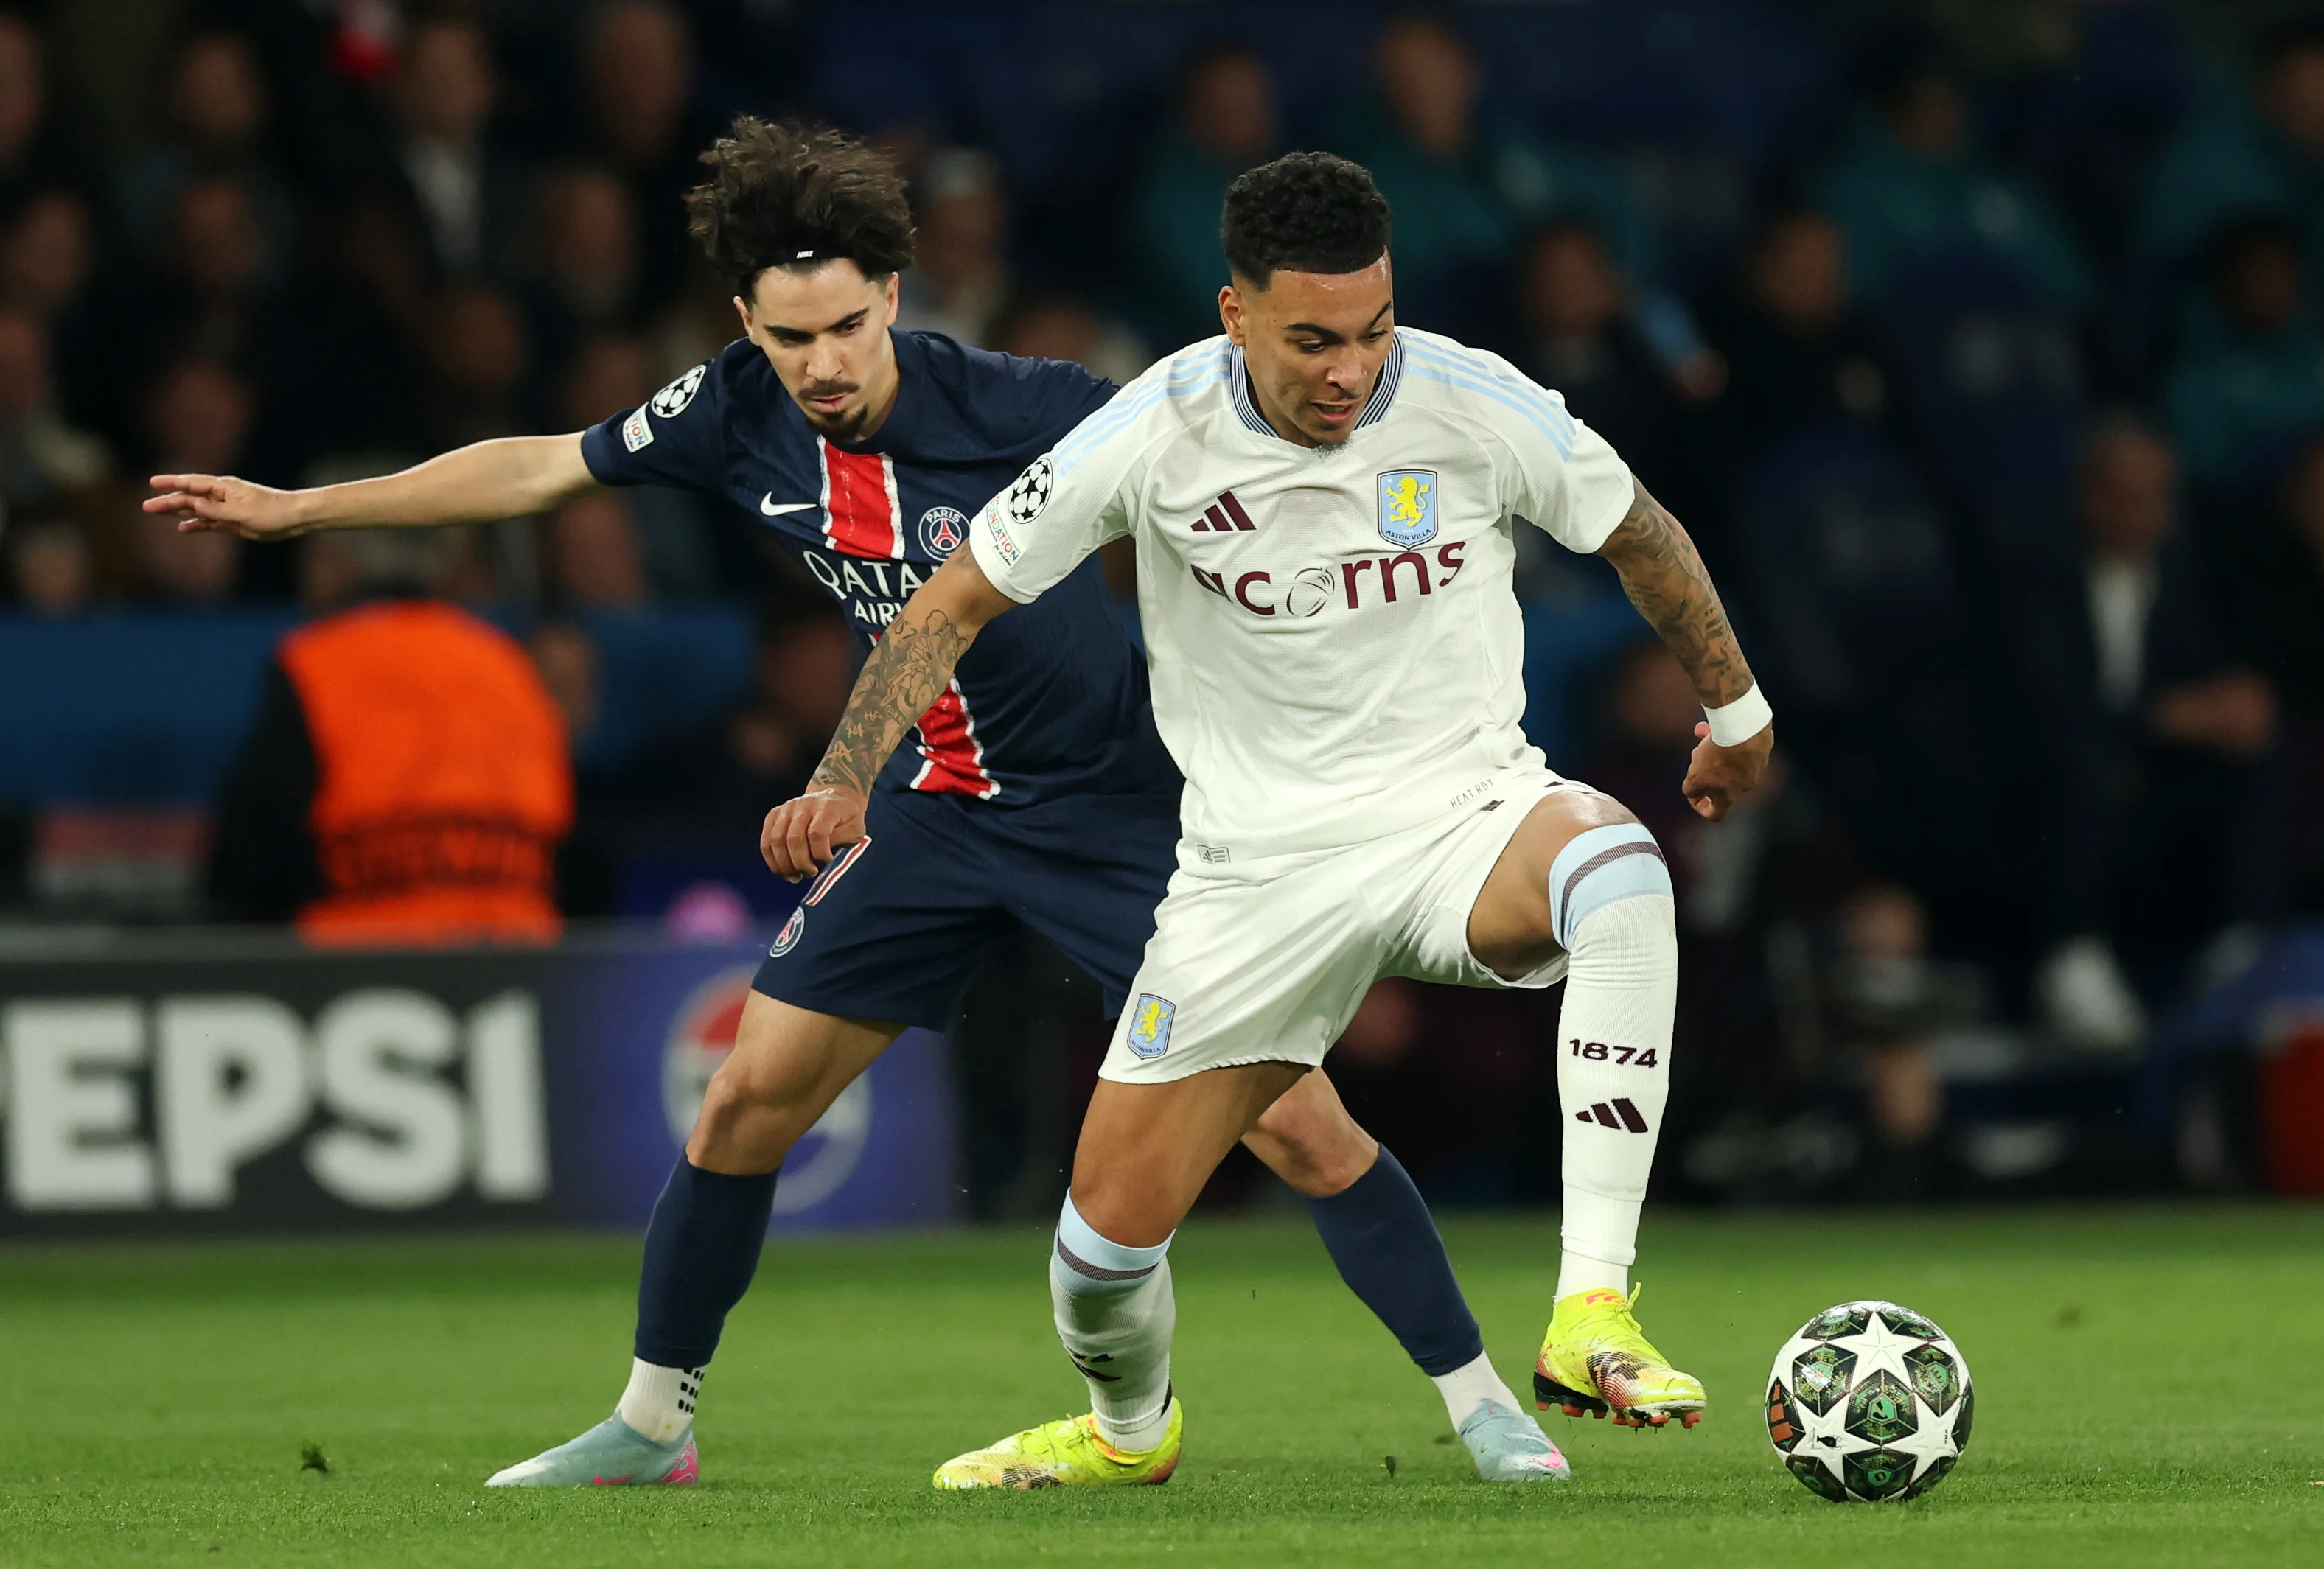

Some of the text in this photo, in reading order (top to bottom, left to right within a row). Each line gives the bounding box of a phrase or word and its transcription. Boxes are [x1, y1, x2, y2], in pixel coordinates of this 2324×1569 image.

[925, 509, 961, 523] PARIS
[1386, 528, 1431, 540] ASTON VILLA
[803, 551, 940, 601] QATA
[1569, 1038, 1658, 1069] 1874
[0, 986, 553, 1210] EPSI
